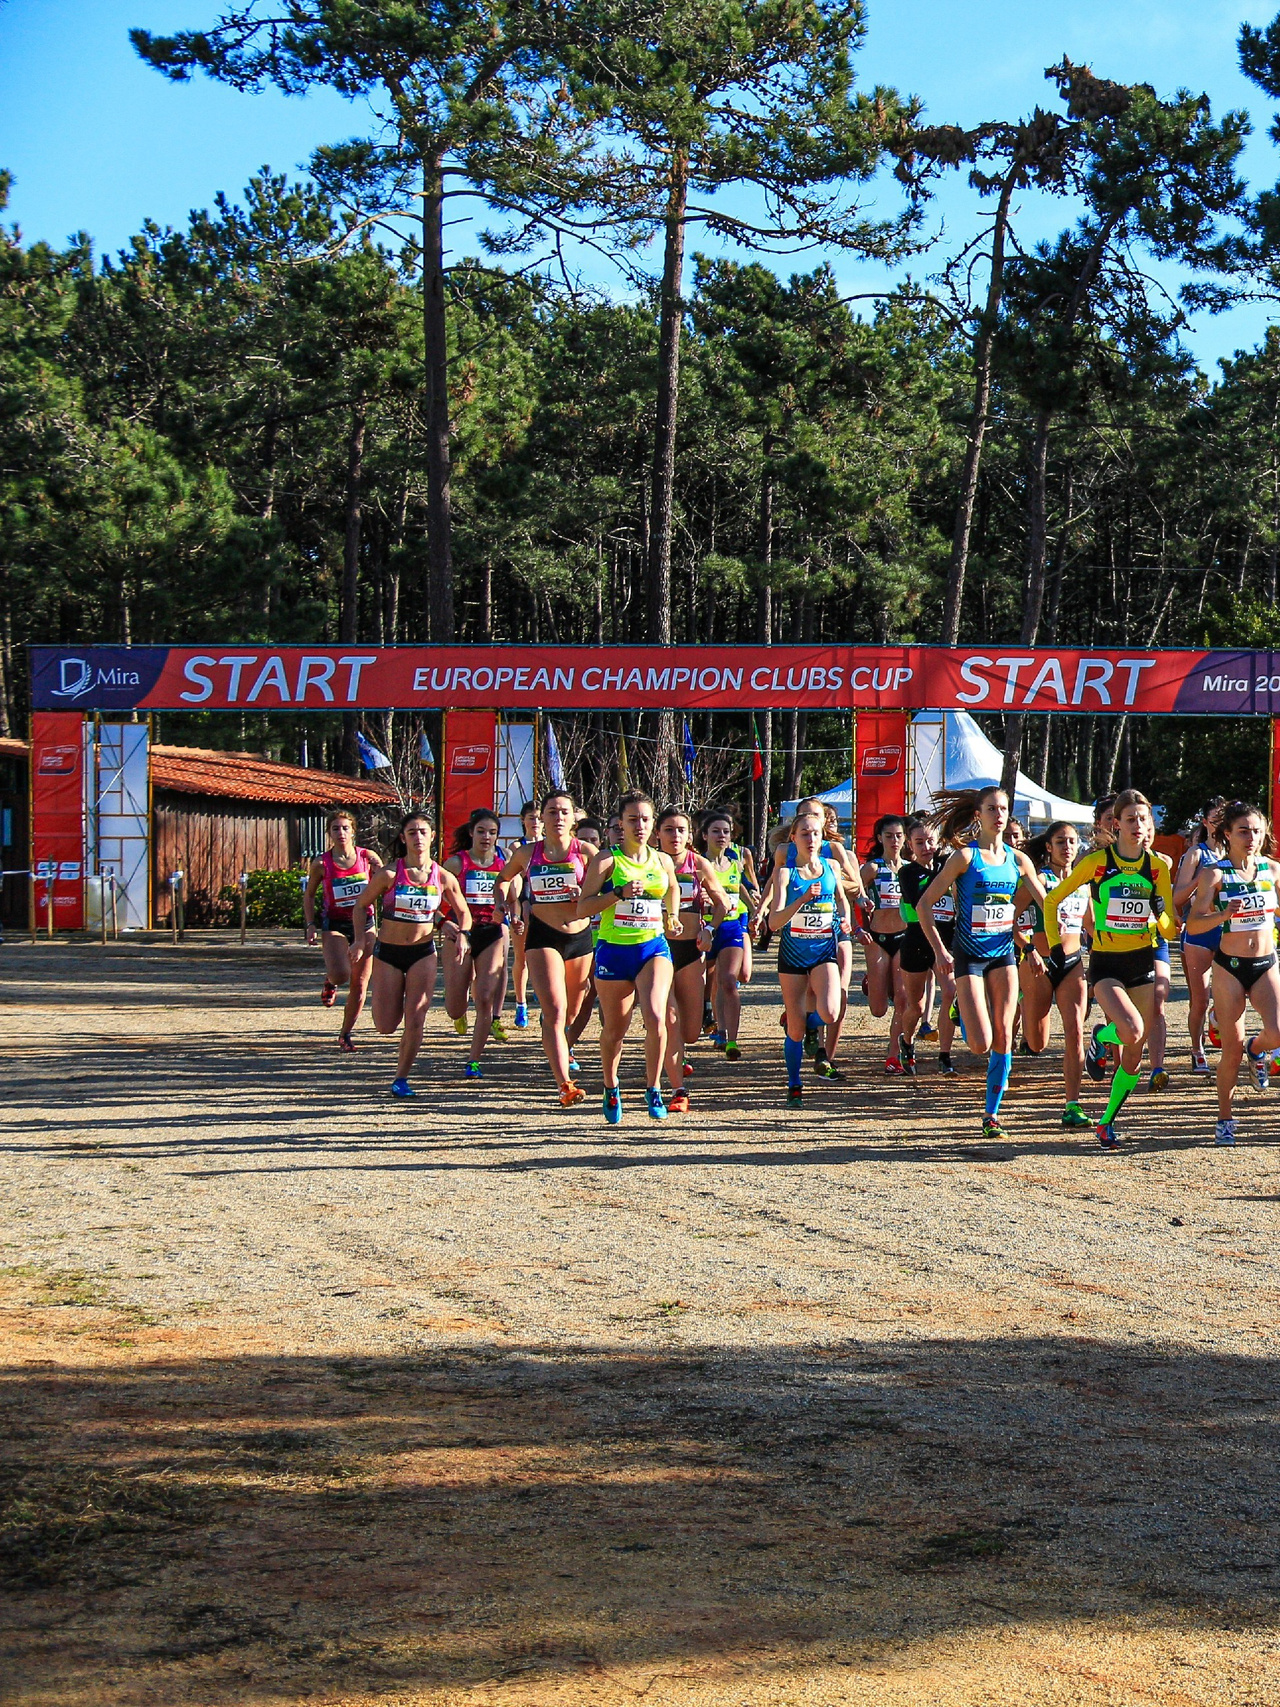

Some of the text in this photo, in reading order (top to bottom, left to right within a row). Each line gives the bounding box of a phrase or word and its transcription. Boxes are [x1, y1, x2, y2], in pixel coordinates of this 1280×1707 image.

[97, 667, 140, 685] Mira
[180, 655, 377, 702] START
[413, 667, 914, 691] EUROPEAN CHAMPION CLUBS CUP
[955, 655, 1156, 706] START
[1202, 674, 1249, 692] Mira
[476, 882, 494, 892] 129
[541, 876, 565, 889] 128
[887, 883, 900, 894] 20
[975, 880, 1015, 890] SPARTA
[342, 885, 361, 896] 130
[408, 897, 428, 909] 141
[1120, 901, 1144, 914] 190
[1243, 895, 1265, 909] 213
[985, 907, 1004, 919] 118
[803, 916, 823, 927] 125
